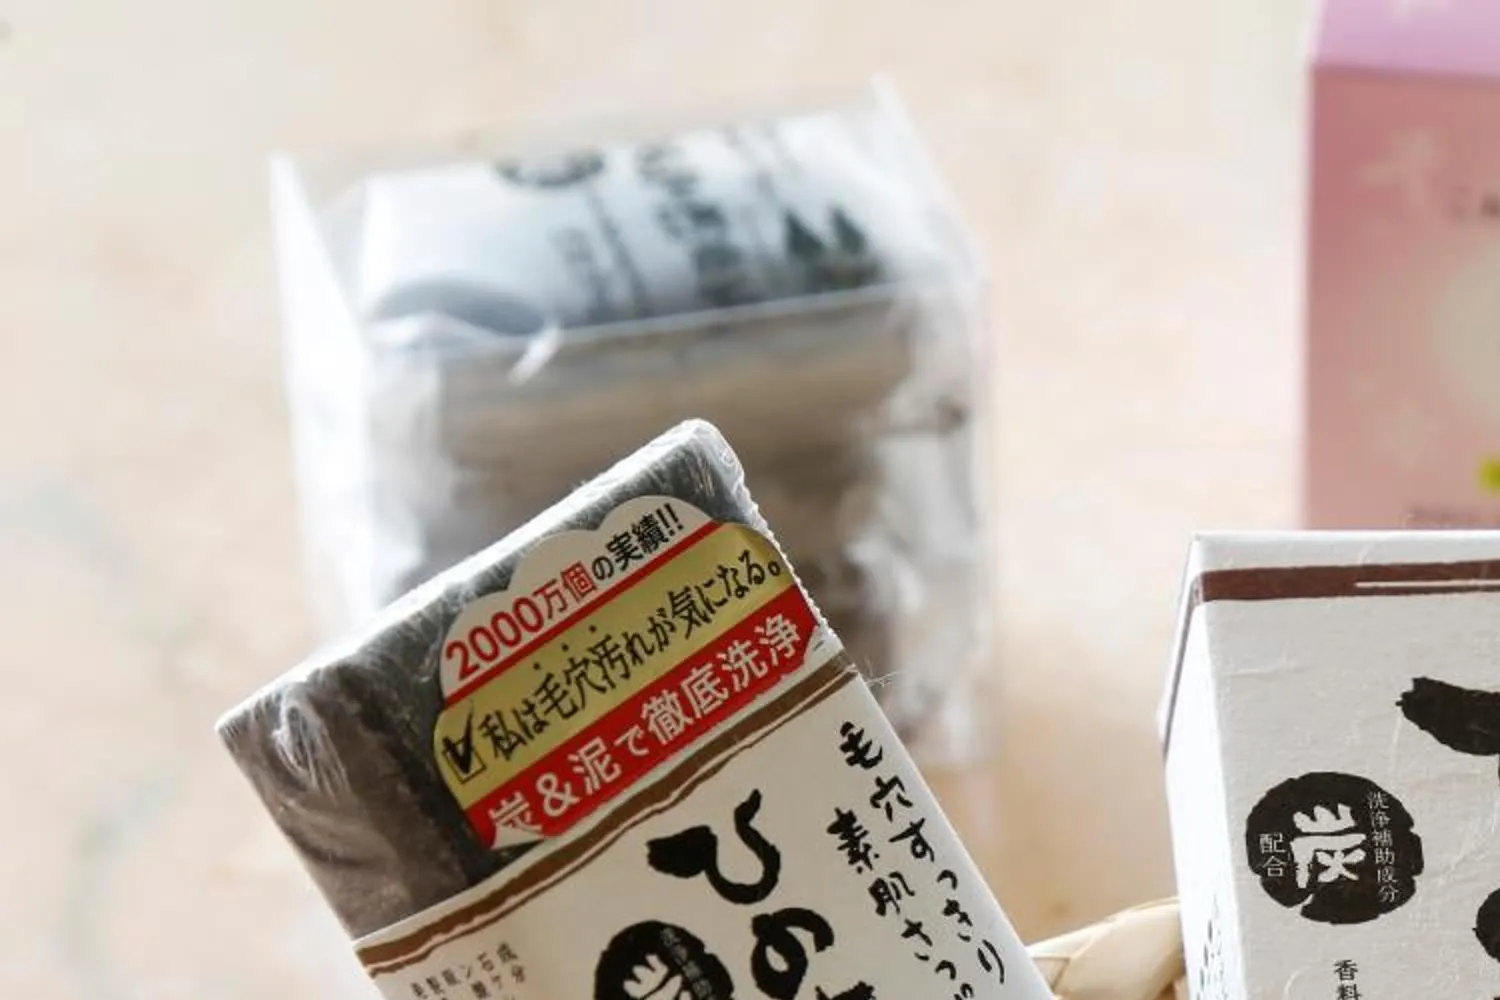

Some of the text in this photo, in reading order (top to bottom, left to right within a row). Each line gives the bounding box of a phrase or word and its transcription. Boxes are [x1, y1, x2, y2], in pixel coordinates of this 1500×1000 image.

[444, 503, 685, 683] 2000万個の実績!!
[478, 549, 781, 762] 私は毛穴汚れが気になる。
[839, 720, 1005, 985] 毛穴すっきり
[1258, 831, 1288, 880] 配合
[1290, 802, 1368, 890] 炭
[1367, 790, 1401, 904] 洗浄補助成分
